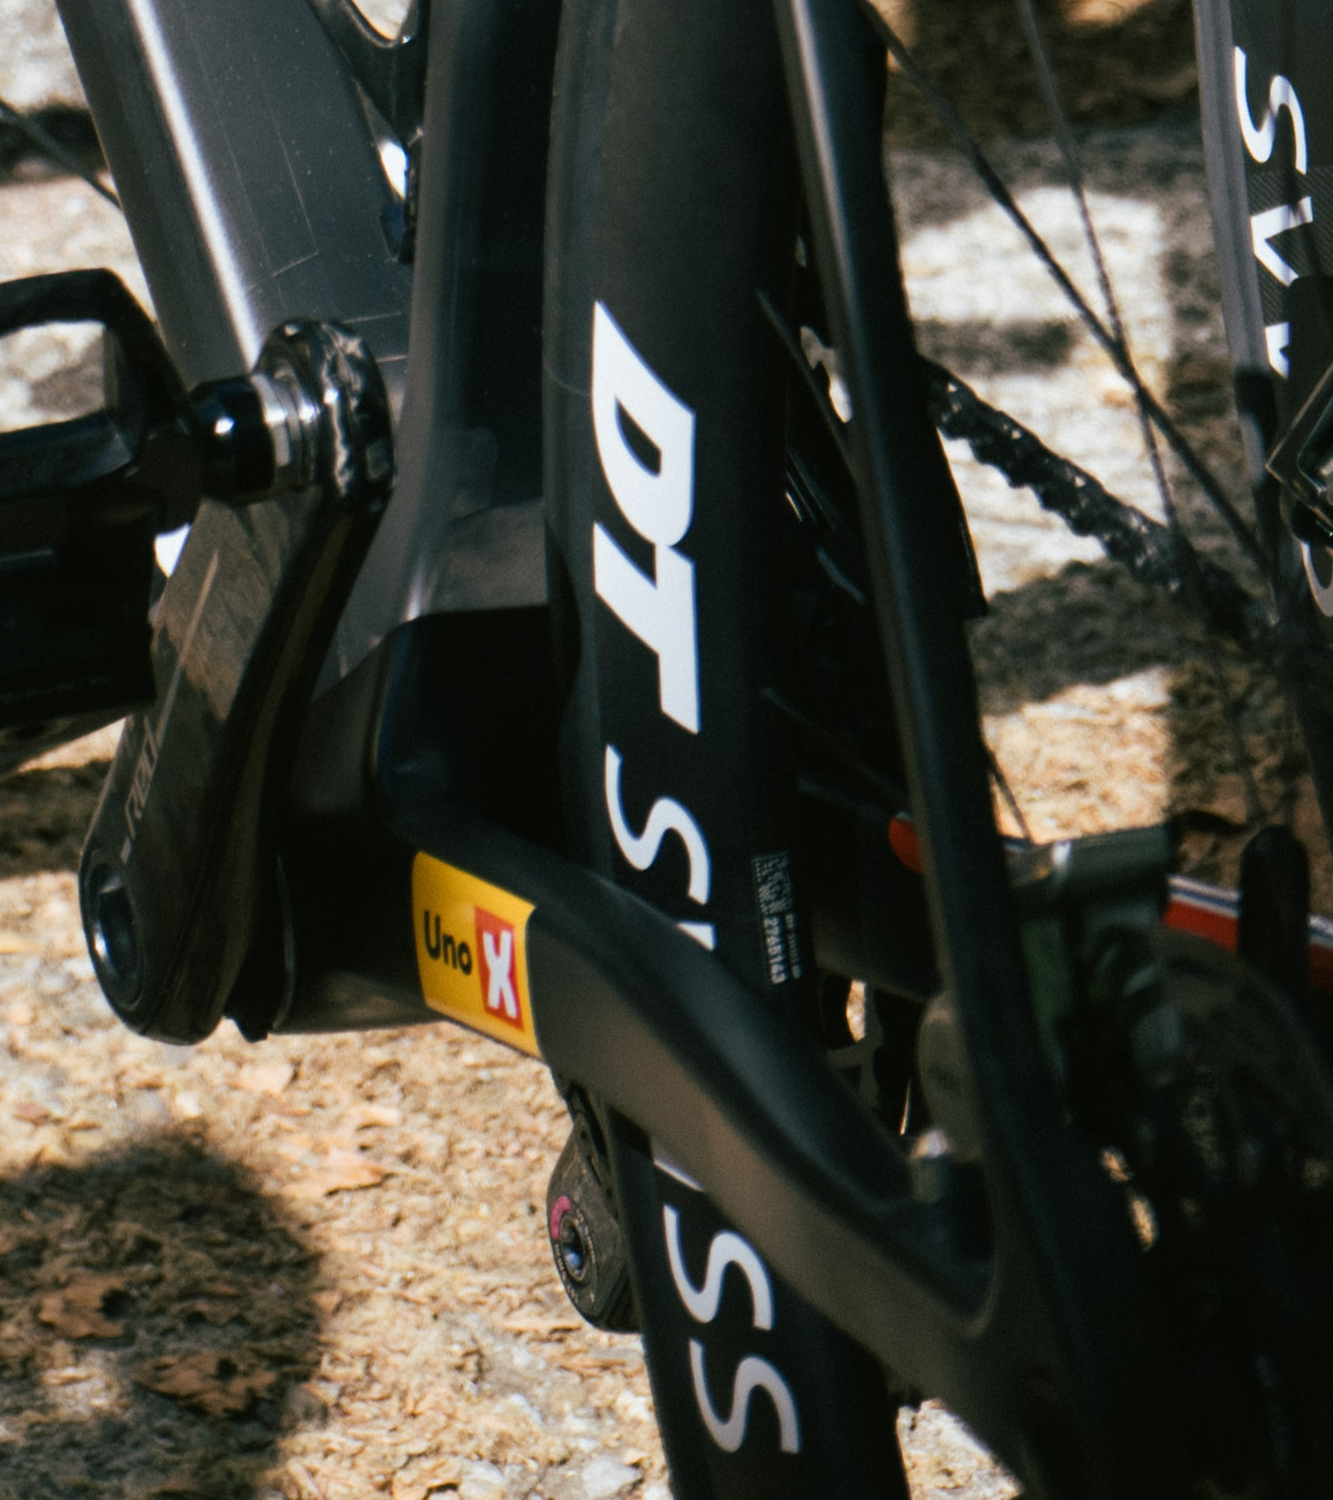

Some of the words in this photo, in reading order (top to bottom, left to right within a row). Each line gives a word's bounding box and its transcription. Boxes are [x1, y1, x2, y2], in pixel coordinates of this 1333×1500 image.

[590, 297, 701, 736] DT
[423, 908, 473, 977] Uno
[481, 928, 519, 1020] X
